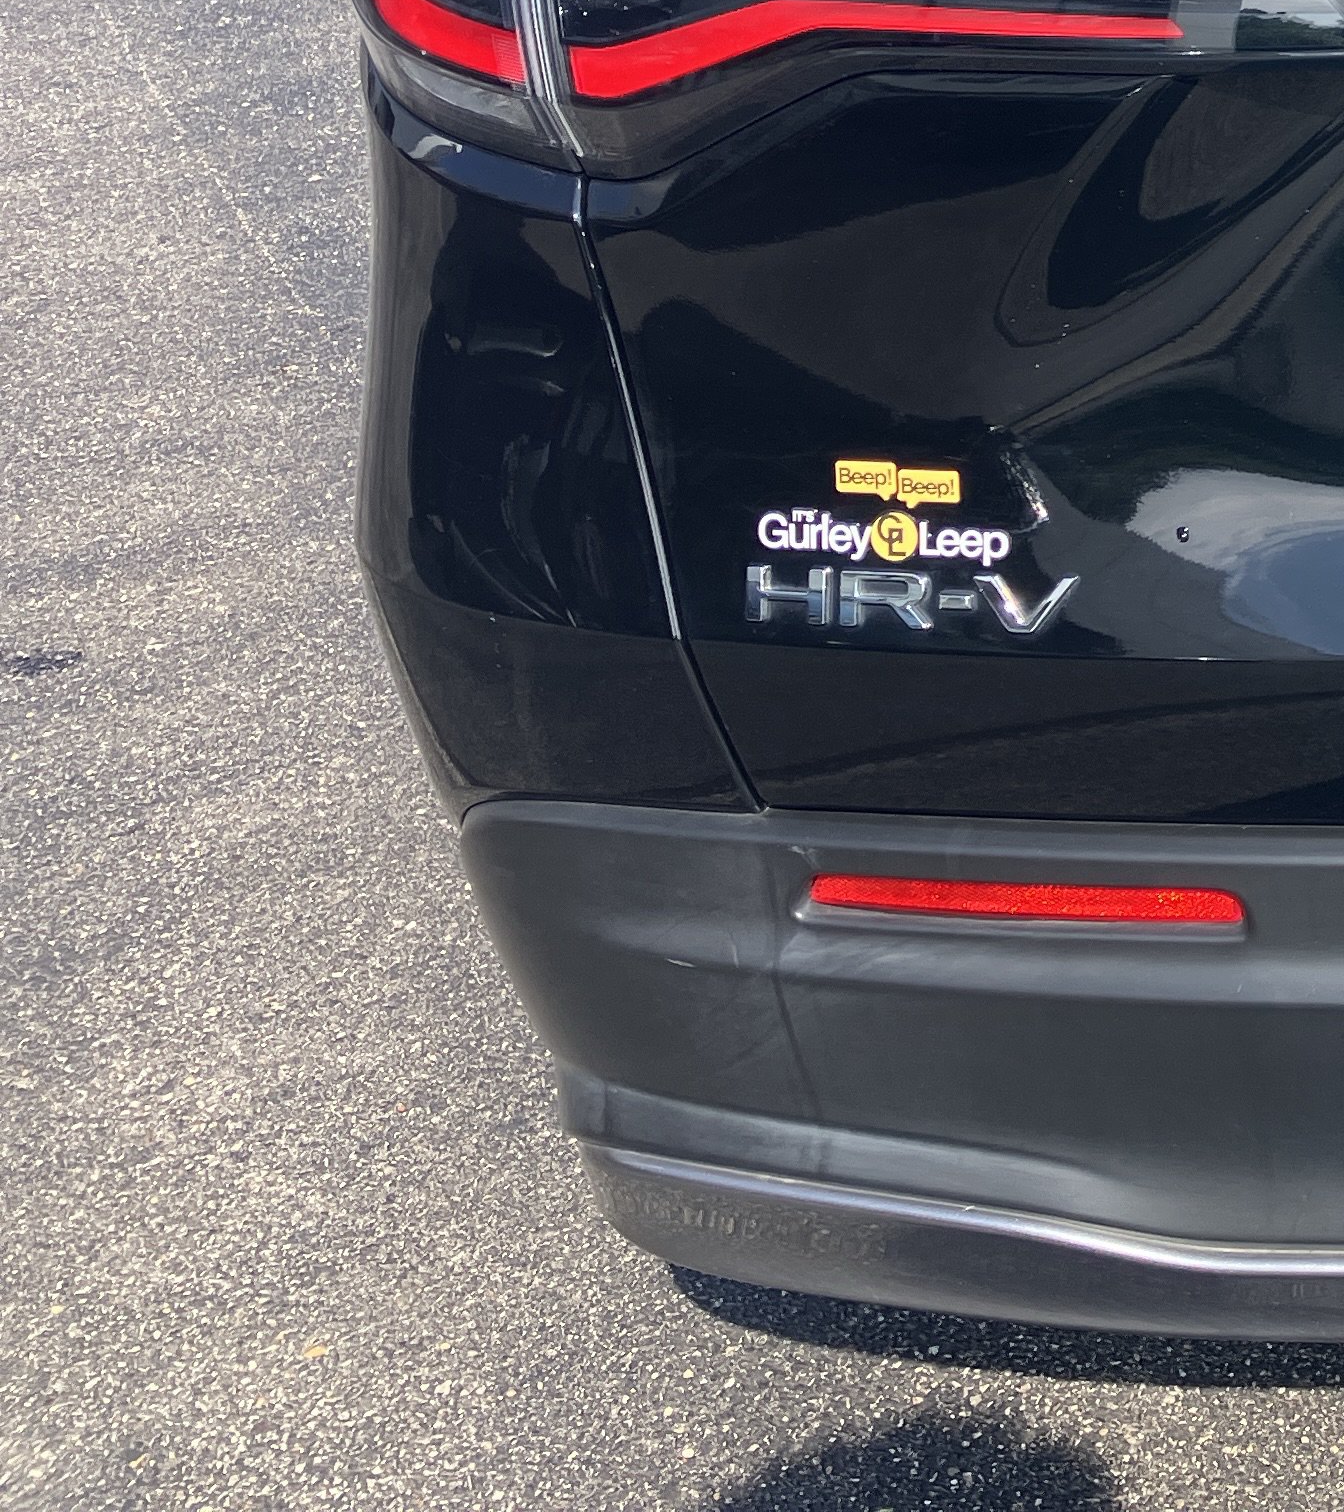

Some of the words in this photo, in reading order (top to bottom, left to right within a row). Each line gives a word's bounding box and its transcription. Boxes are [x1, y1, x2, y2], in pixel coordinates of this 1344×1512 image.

[839, 467, 893, 489] Beep!
[901, 477, 955, 499] Beep!
[758, 511, 872, 561] Gurley
[918, 519, 1011, 567] Leep
[745, 562, 1081, 635] HR-V
